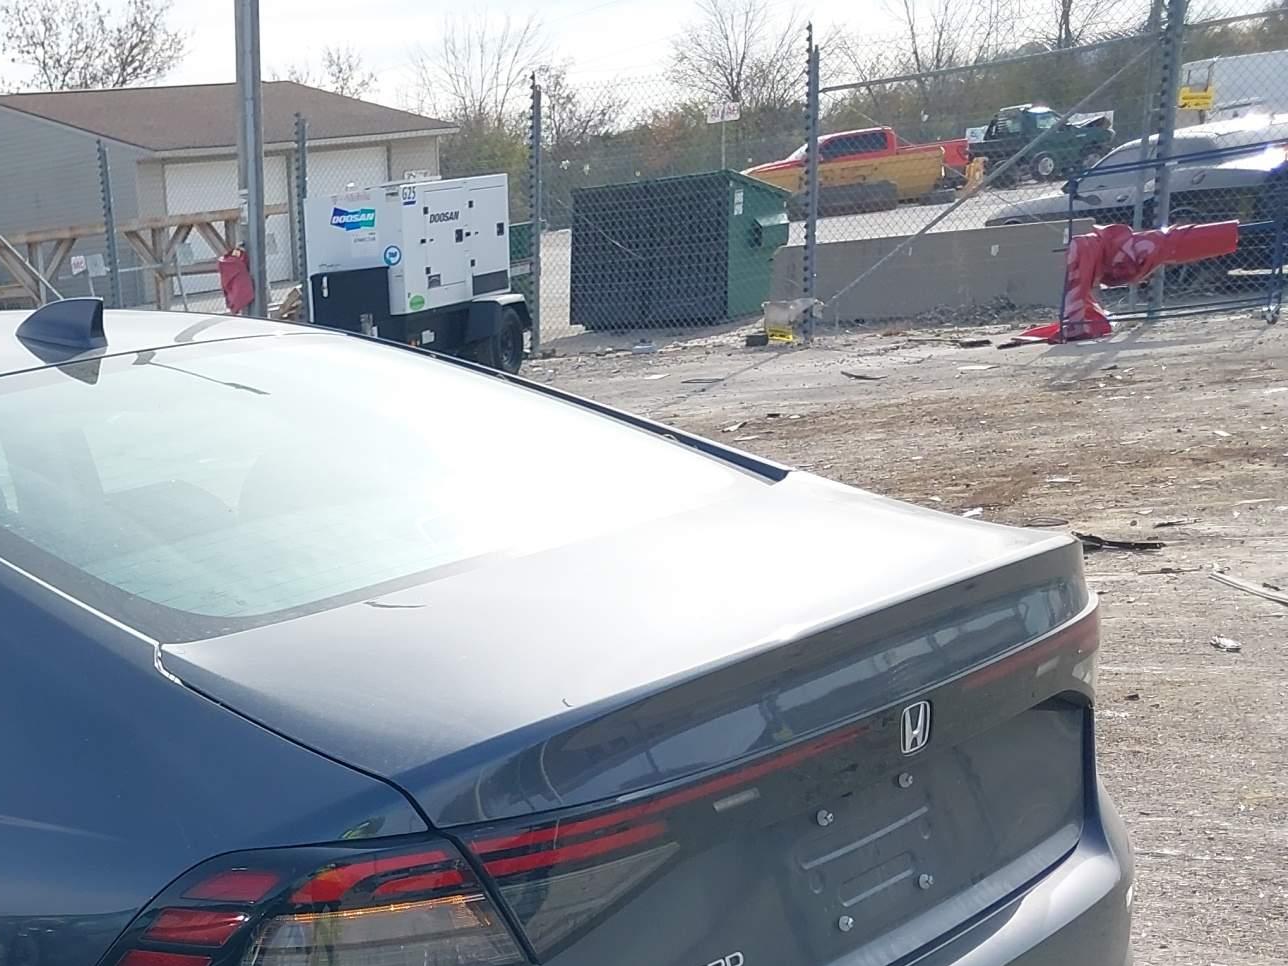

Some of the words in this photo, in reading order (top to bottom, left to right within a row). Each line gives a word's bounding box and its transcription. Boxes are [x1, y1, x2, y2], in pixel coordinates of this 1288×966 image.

[401, 186, 417, 201] G25
[332, 213, 374, 225] DOOSAN
[429, 211, 460, 225] DOOSAN
